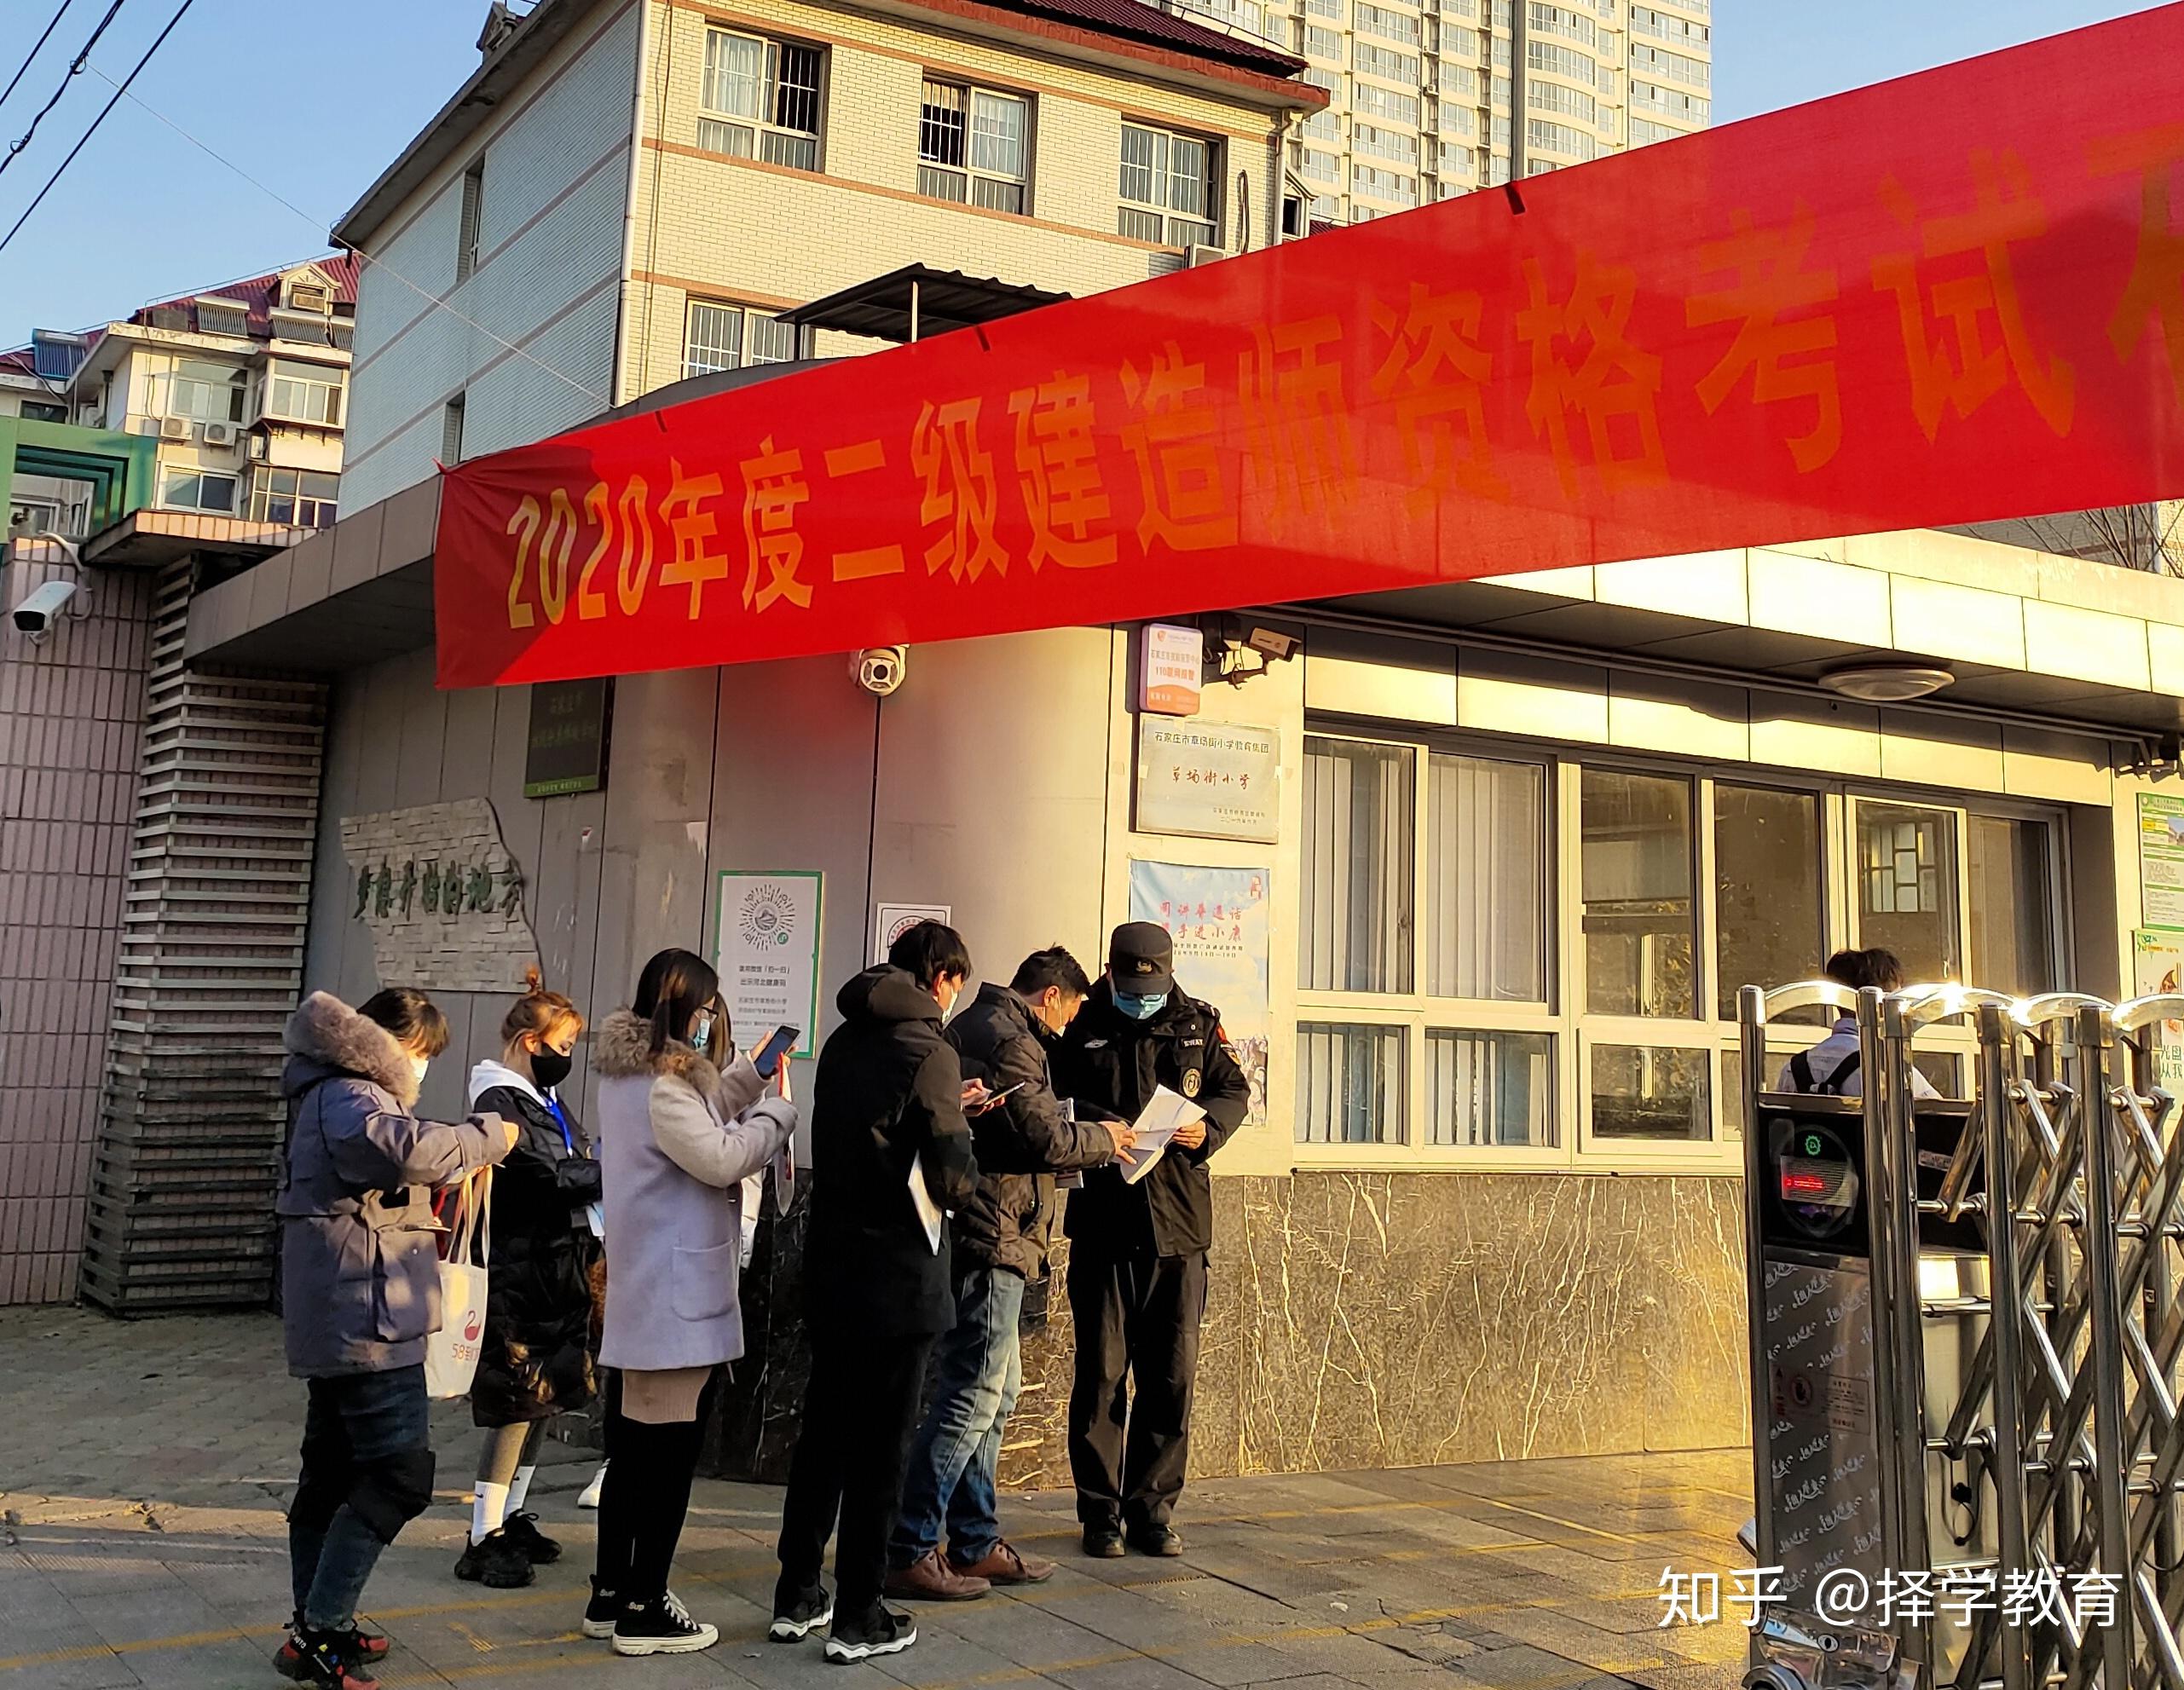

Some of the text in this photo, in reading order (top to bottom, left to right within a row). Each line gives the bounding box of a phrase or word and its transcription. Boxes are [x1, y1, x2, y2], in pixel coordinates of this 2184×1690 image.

[1172, 766, 1251, 790] 草场街小学
